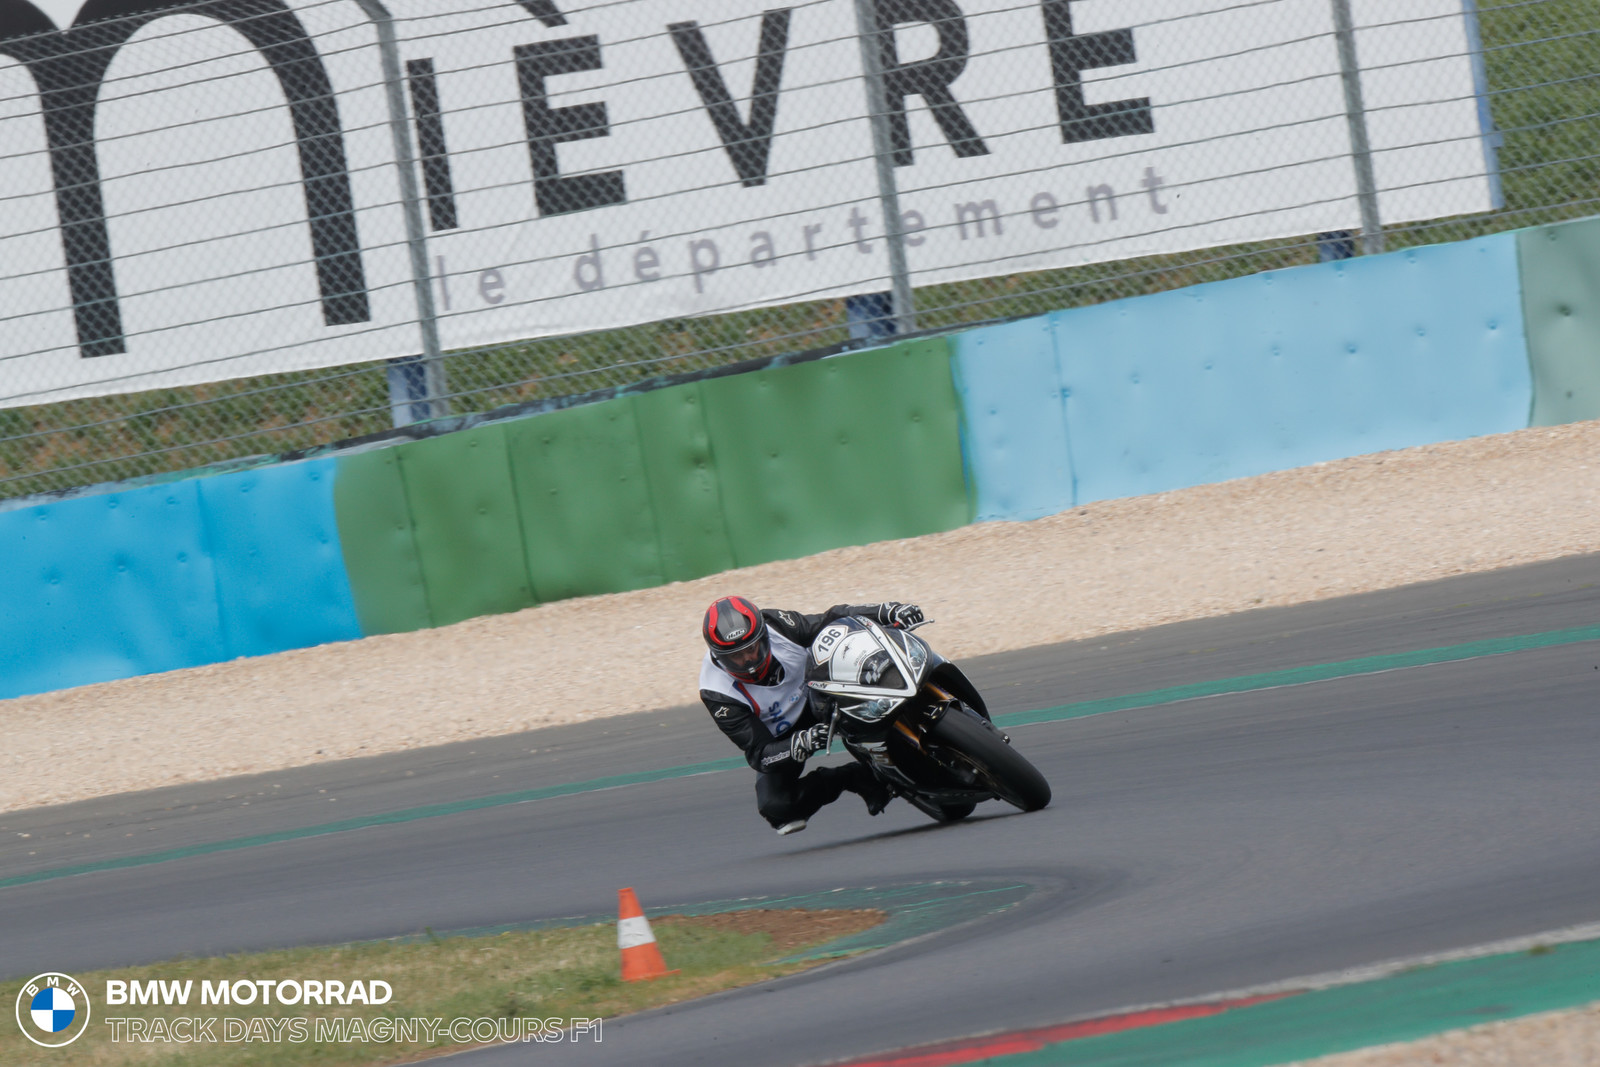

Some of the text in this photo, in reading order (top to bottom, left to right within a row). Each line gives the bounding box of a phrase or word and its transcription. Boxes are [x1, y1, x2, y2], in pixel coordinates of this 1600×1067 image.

[435, 166, 1170, 312] le département
[817, 629, 842, 653] 196
